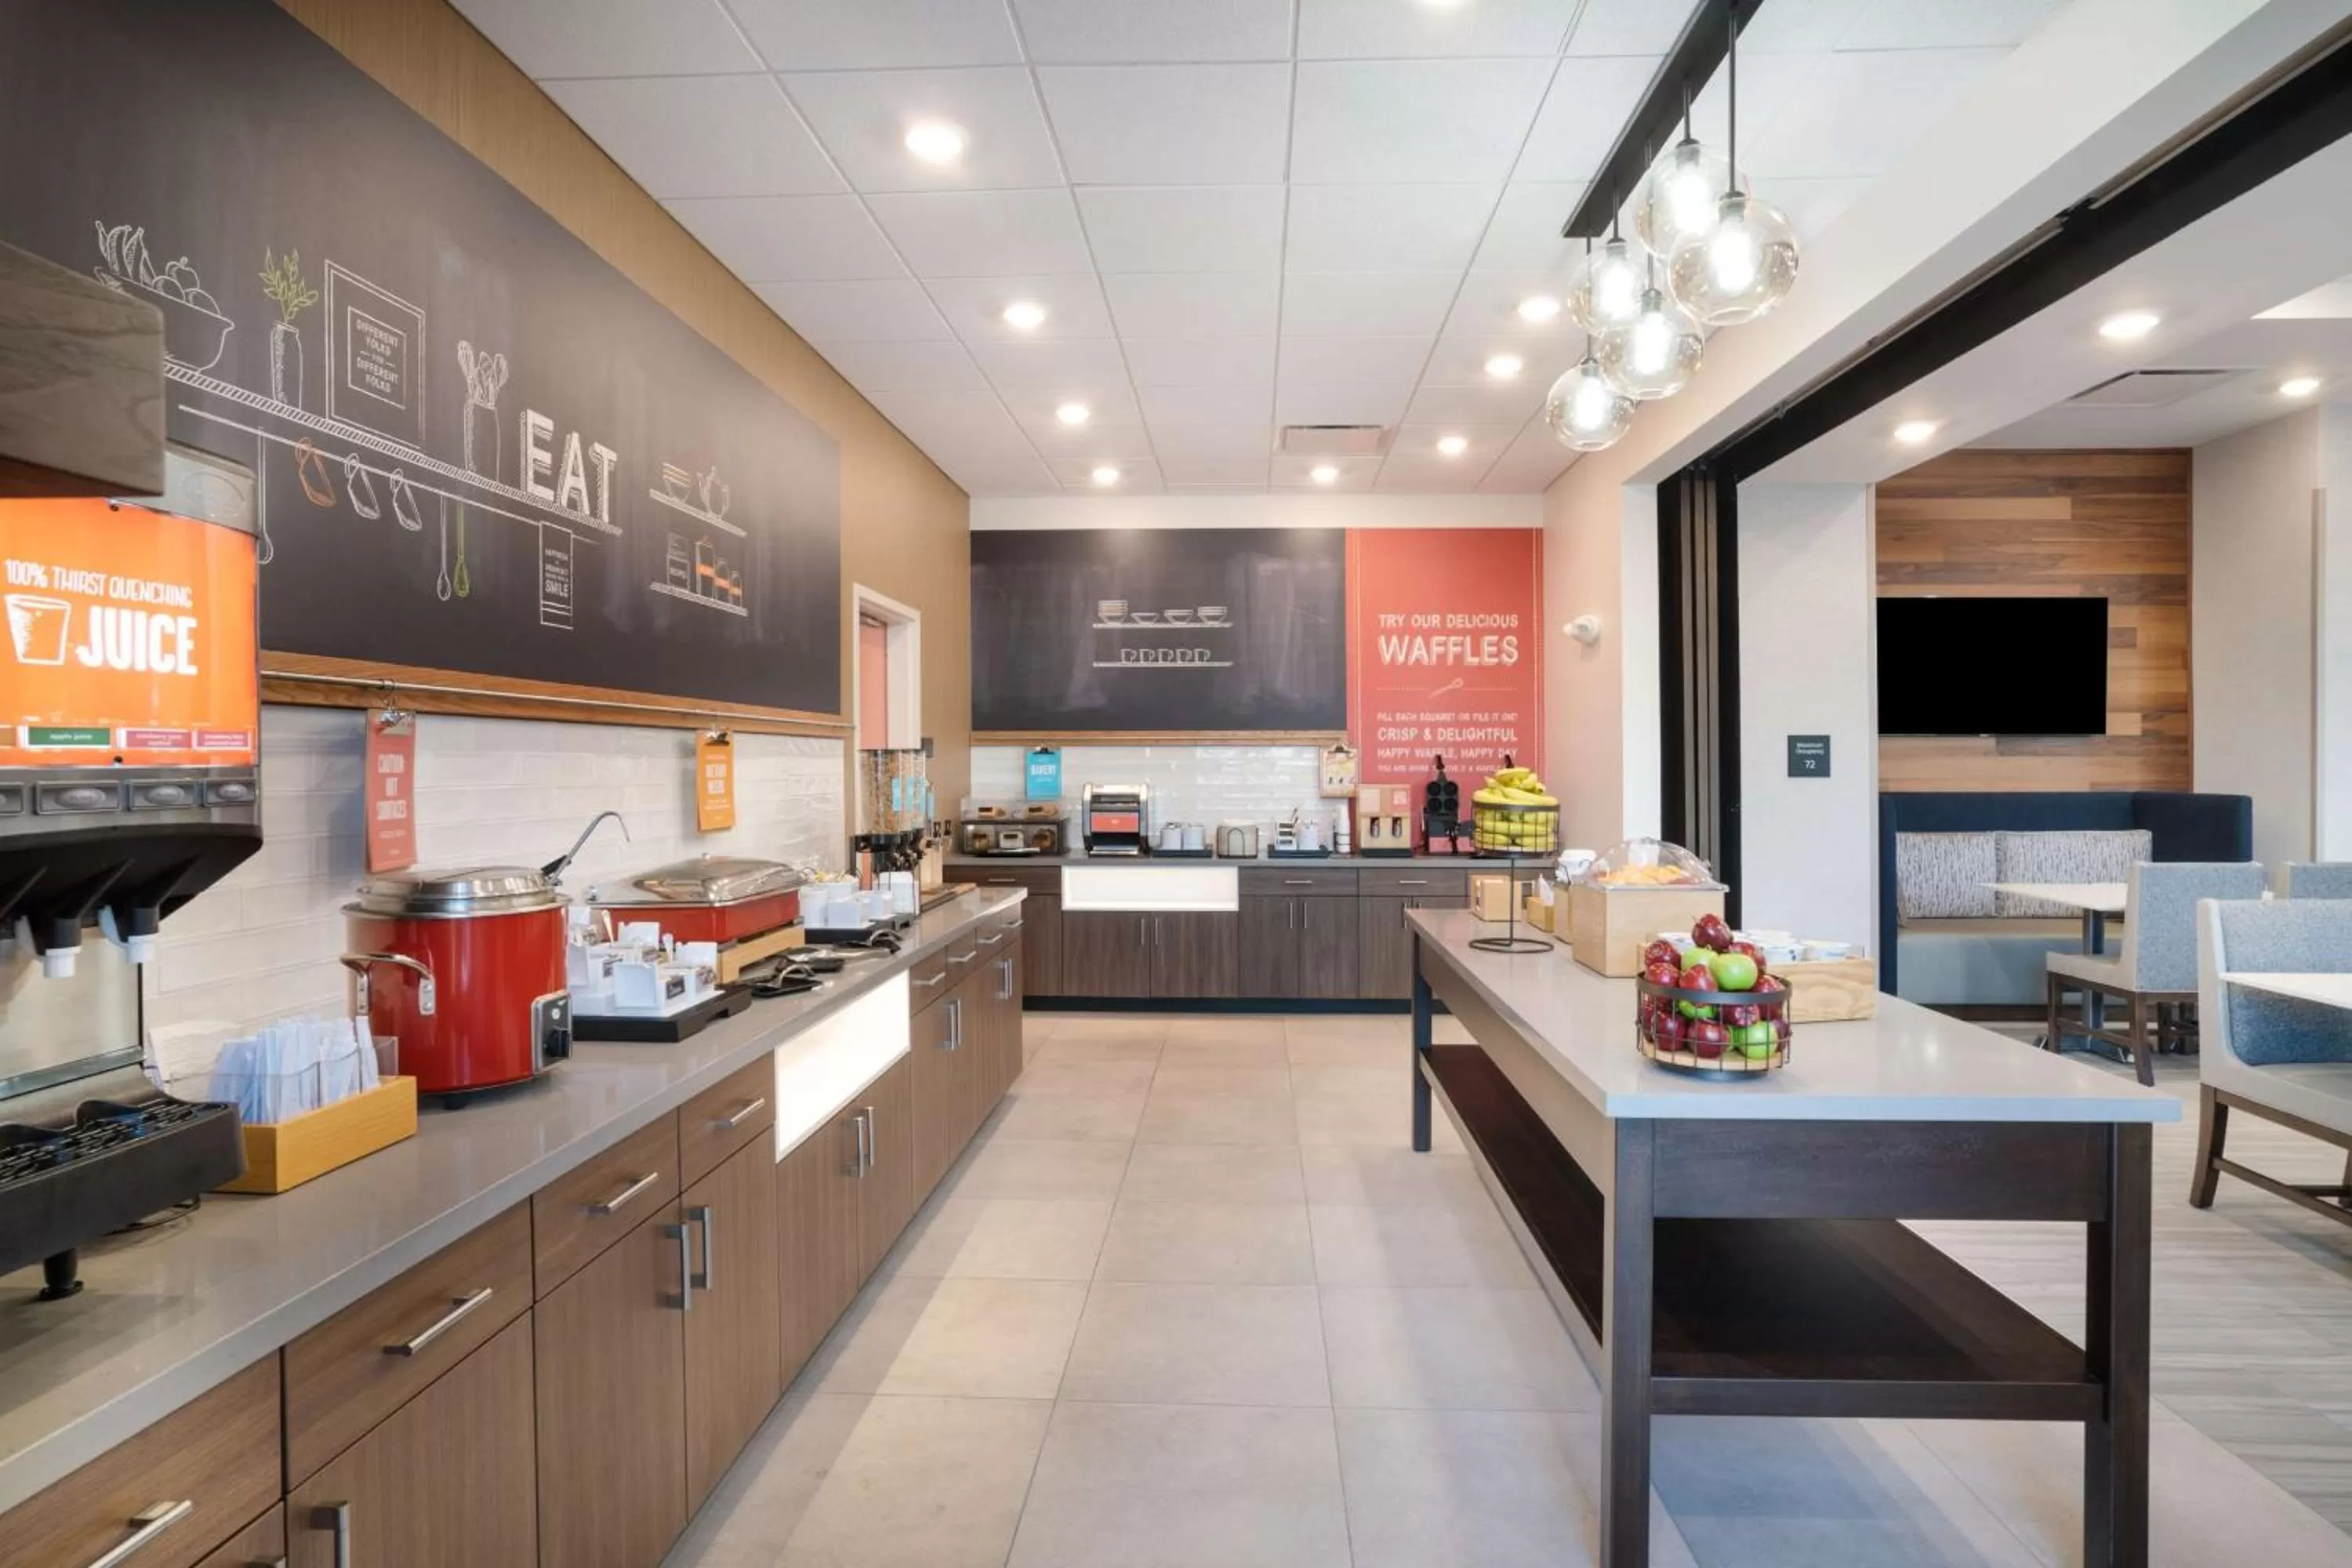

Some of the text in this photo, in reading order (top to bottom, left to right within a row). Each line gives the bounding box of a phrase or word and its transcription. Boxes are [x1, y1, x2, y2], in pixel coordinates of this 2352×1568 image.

[521, 408, 618, 524] EAT
[5, 559, 193, 608] 100% THIRST QUENCHING
[1377, 614, 1519, 628] TRY OUR DELICIOUS
[75, 605, 198, 676] JUICE
[1377, 634, 1519, 666] WAFFLES
[1377, 727, 1519, 742] CRISP & DELIGHTFUL
[1377, 746, 1411, 759] HAPPY
[1461, 746, 1494, 759] HAPPY
[1805, 760, 1816, 769] 72
